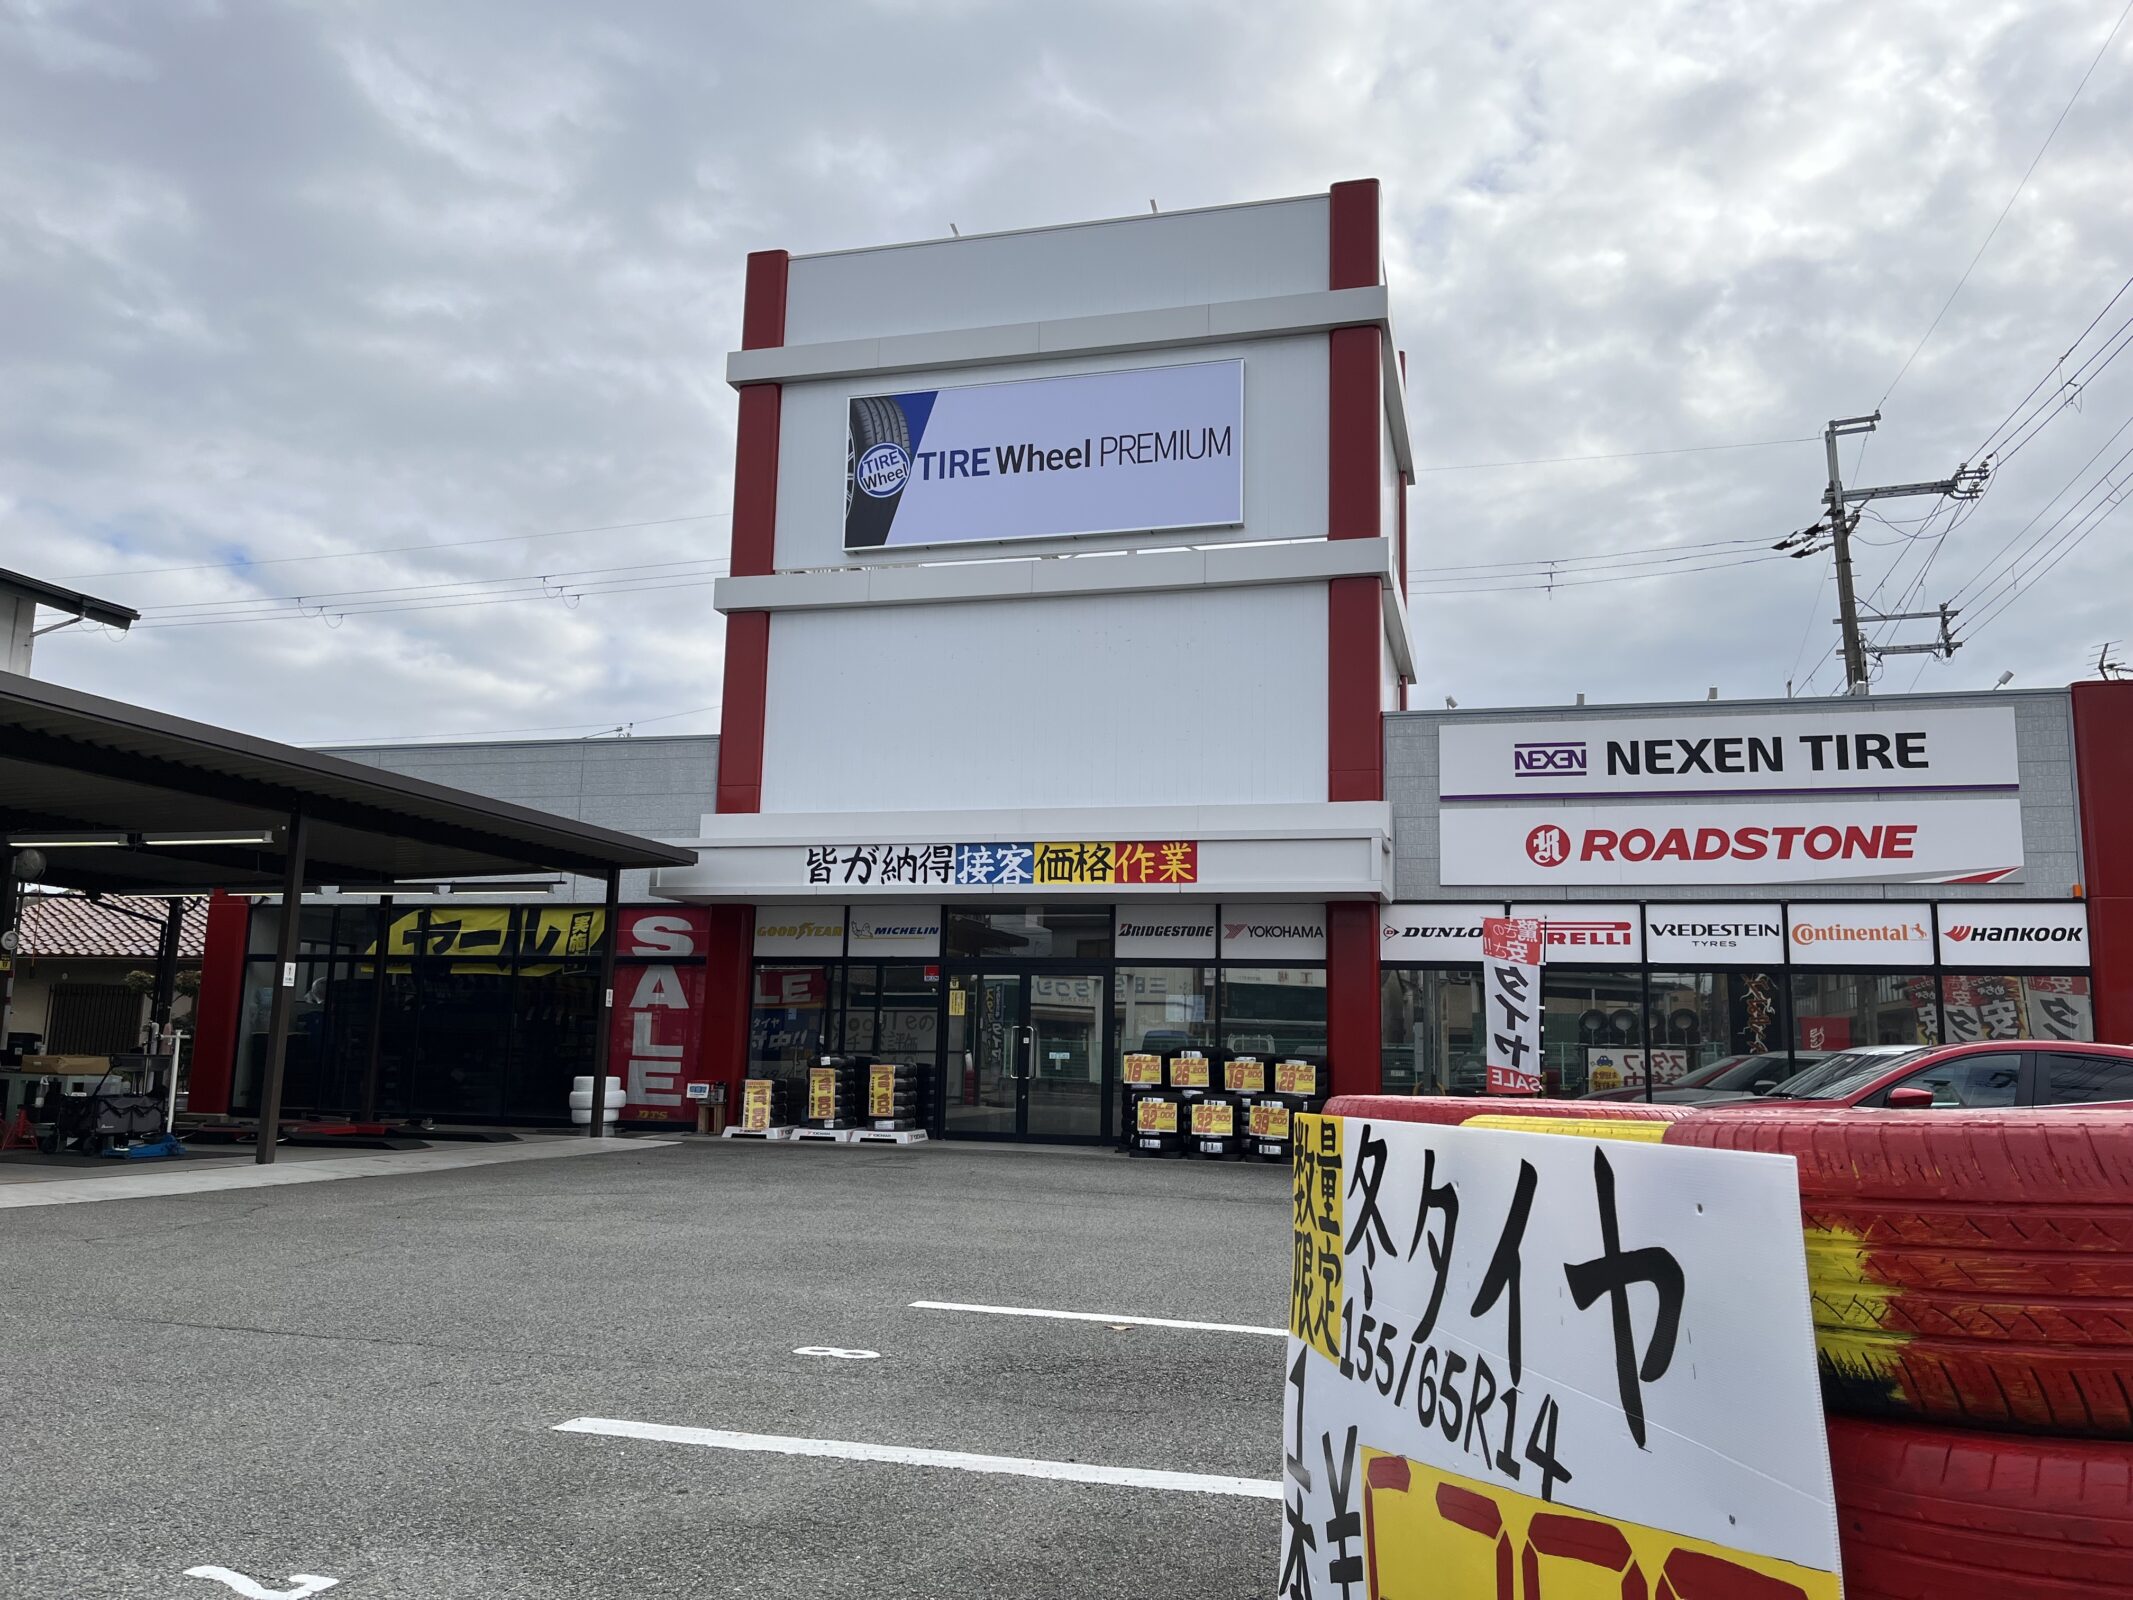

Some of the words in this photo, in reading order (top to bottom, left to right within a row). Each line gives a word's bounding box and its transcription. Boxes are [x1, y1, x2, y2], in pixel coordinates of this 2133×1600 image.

[863, 449, 901, 475] TIRE
[917, 447, 991, 481] TIRE
[995, 438, 1091, 475] Wheel
[1099, 425, 1232, 468] PREMIUM
[862, 462, 909, 490] Wheel
[1514, 749, 1587, 770] NEXEN
[1606, 736, 1784, 776] NEXEN
[1798, 731, 1930, 772] TIRE
[1579, 824, 1918, 862] ROADSTONE
[756, 924, 844, 938] GOODYEAR
[874, 926, 940, 936] MICHELIN
[1118, 923, 1215, 937] BRIDGESTONE
[1247, 925, 1324, 938] YOKOHAMA
[1402, 927, 1484, 938] DUNLO
[1649, 923, 1780, 937] VREDESTEIN
[1791, 923, 1909, 946] Continental
[626, 915, 695, 1107] SALE
[1294, 1117, 1343, 1237] 数量
[1291, 1230, 1341, 1358] 限定
[1344, 1123, 1686, 1452] 冬タイヤ
[1339, 1297, 1573, 1502] 155/65R14
